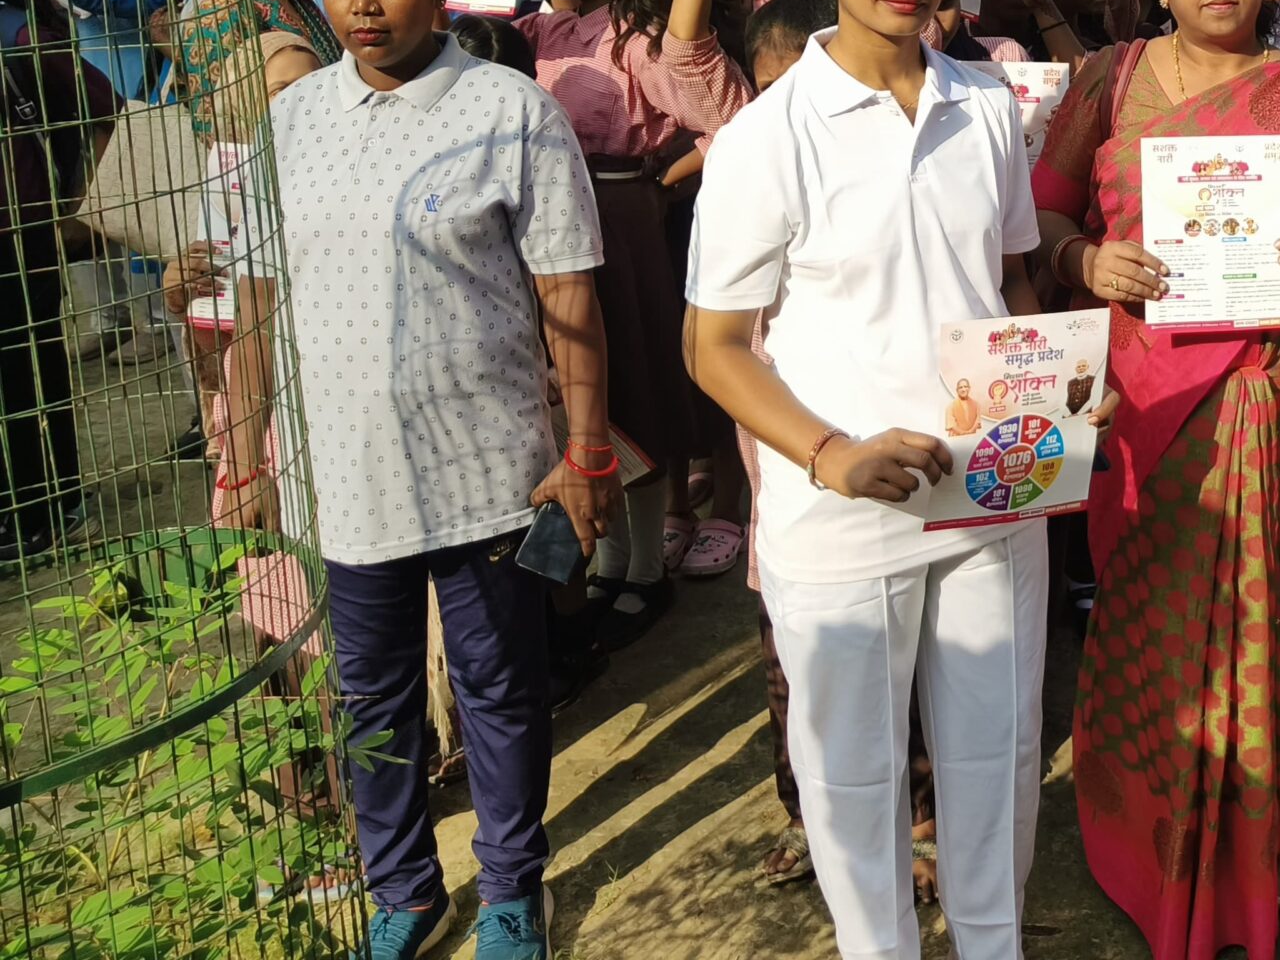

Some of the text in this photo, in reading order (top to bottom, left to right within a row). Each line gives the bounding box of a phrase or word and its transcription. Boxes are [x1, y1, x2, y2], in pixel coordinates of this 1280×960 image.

[1037, 347, 1064, 361] प्रदेश
[998, 423, 1017, 434] 1930
[1003, 451, 1032, 467] 1076
